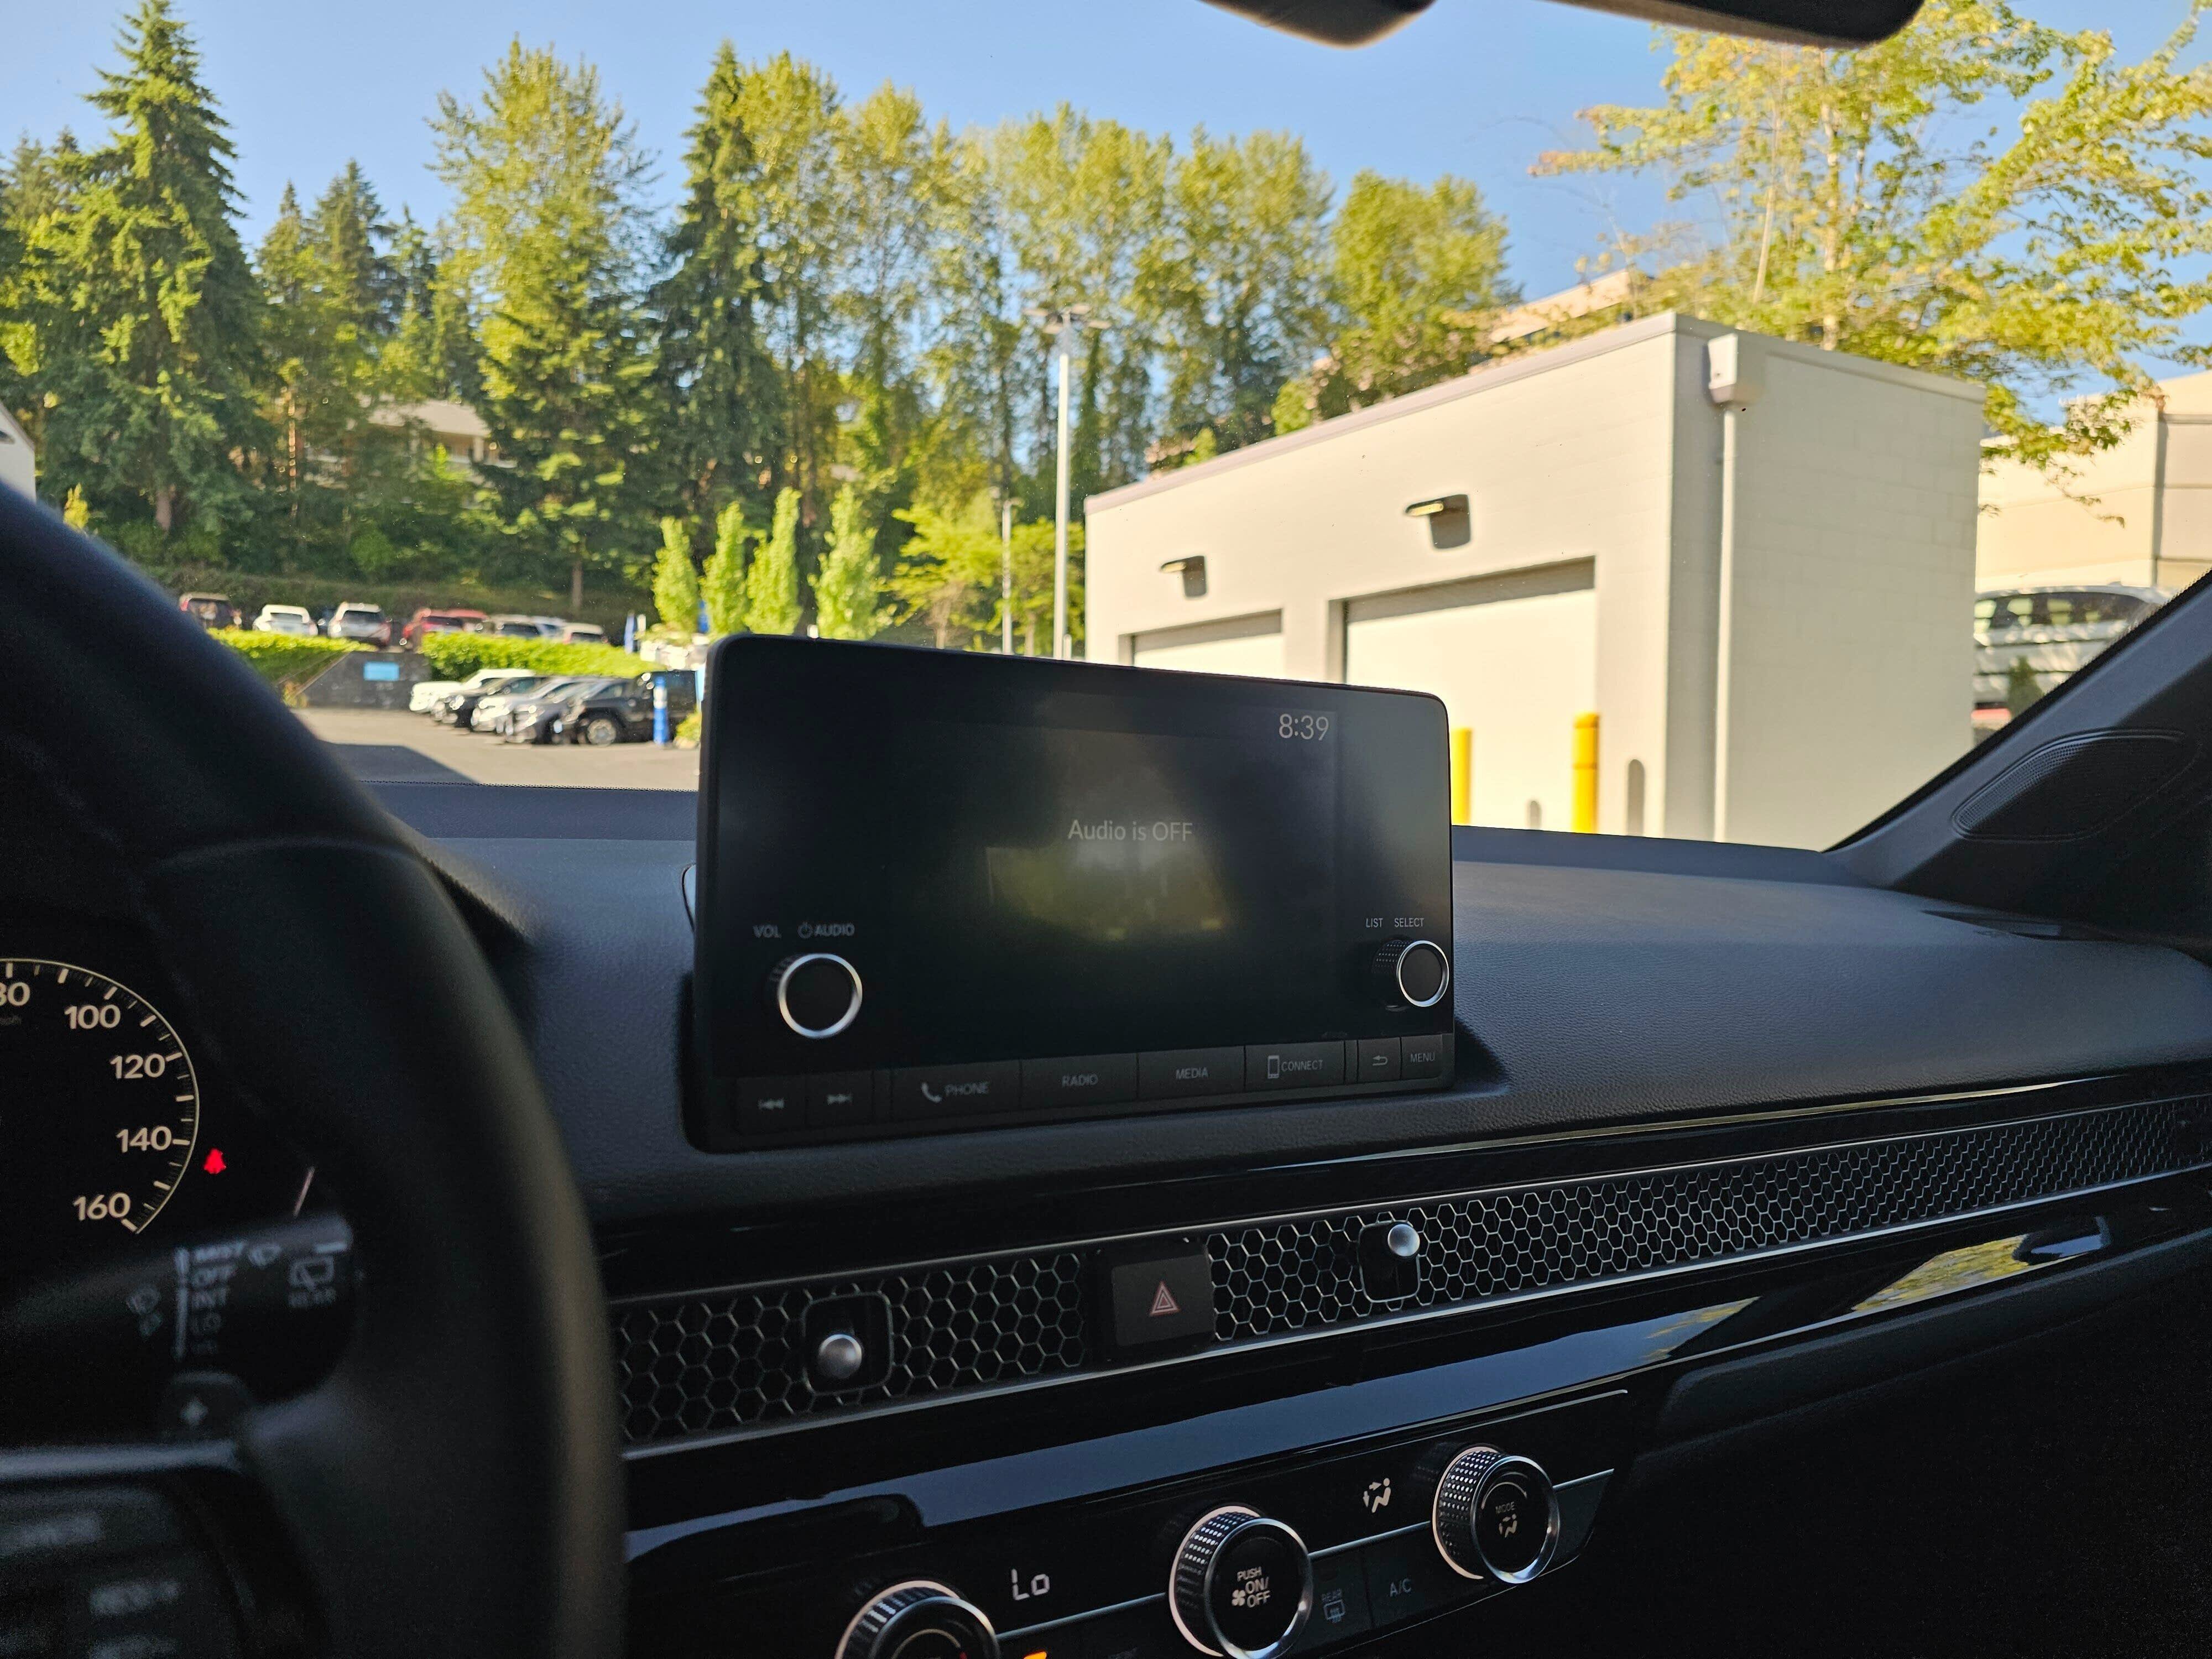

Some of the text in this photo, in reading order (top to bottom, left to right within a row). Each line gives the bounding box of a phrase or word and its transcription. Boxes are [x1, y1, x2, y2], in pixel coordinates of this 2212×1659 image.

[1279, 713, 1329, 741] 8:39
[1068, 819, 1193, 841] Audio is OFF
[815, 922, 855, 937] AUDIO
[1365, 917, 1384, 928] LIST
[1394, 917, 1425, 927] SELECT
[752, 924, 782, 938] VOL
[64, 1004, 121, 1030] 100
[1281, 1059, 1323, 1072] CONNECT
[1410, 1052, 1436, 1063] MENU
[110, 1053, 165, 1079] 120
[1176, 1067, 1209, 1079] MEDIA
[1061, 1073, 1098, 1088] RADIO
[943, 1081, 990, 1097] PHONE
[116, 1126, 172, 1153] 140
[72, 1192, 131, 1221] 160
[1495, 1501, 1516, 1514] MODE
[1237, 1566, 1262, 1582] PUSH
[1245, 1577, 1269, 1594] ON/
[1390, 1578, 1412, 1597] A/C
[1246, 1590, 1271, 1608] OFF
